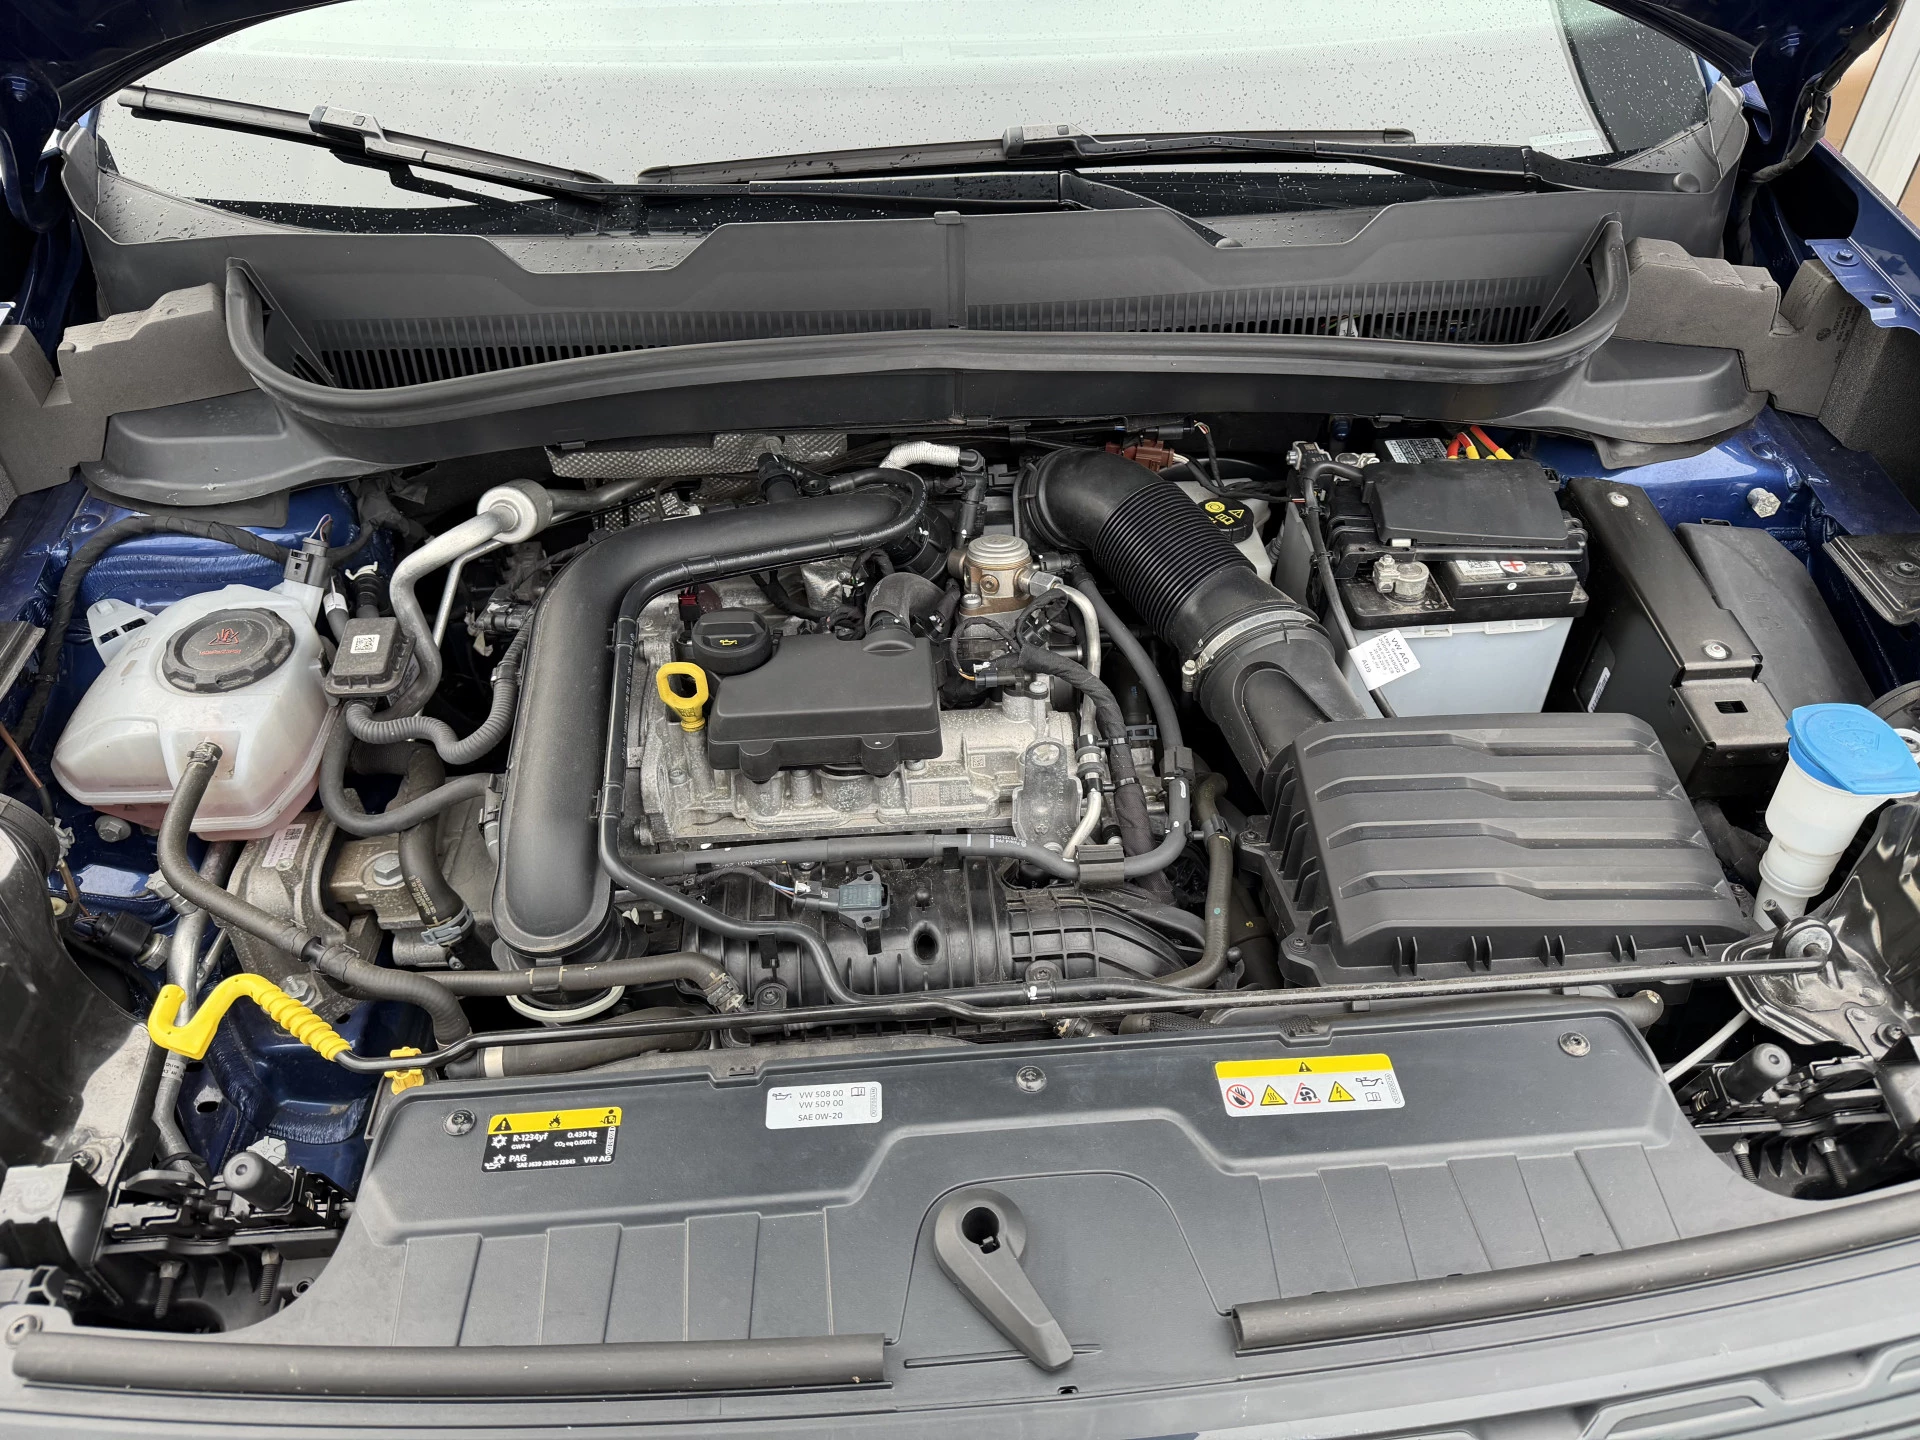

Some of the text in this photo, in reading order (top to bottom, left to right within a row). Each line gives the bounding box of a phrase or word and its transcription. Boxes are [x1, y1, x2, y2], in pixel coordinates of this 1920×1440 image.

[1391, 637, 1410, 665] VW AG
[799, 1089, 844, 1099] VW 508 00
[799, 1099, 844, 1109] VW 509 00
[815, 1111, 843, 1121] 0W-20
[512, 1132, 549, 1142] R-1234yf
[567, 1130, 598, 1139] 0.430 kg
[508, 1154, 527, 1163] PAG
[583, 1155, 612, 1164] VW AG
